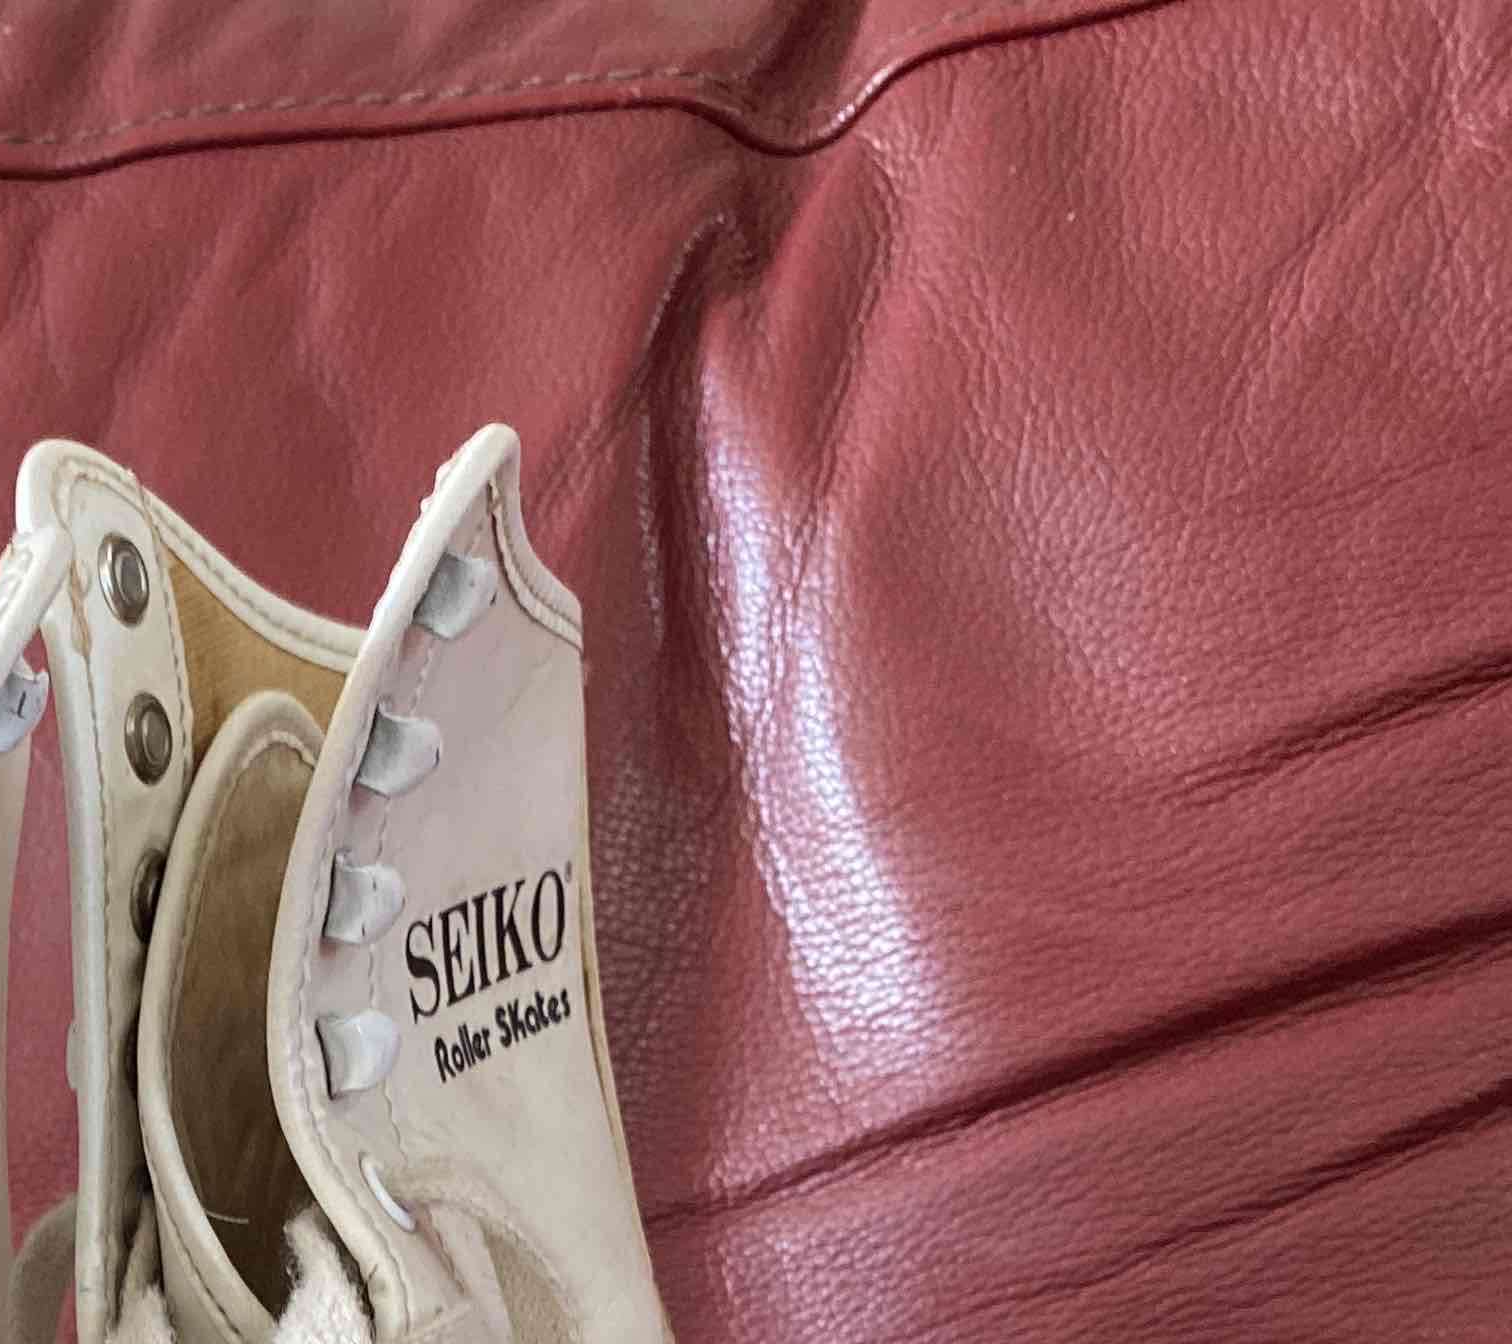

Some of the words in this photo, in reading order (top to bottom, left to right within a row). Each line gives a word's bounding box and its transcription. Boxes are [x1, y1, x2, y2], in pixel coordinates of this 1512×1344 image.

[404, 868, 566, 1024] SEIKO
[434, 1023, 492, 1084] Roller
[495, 988, 572, 1049] Skates
